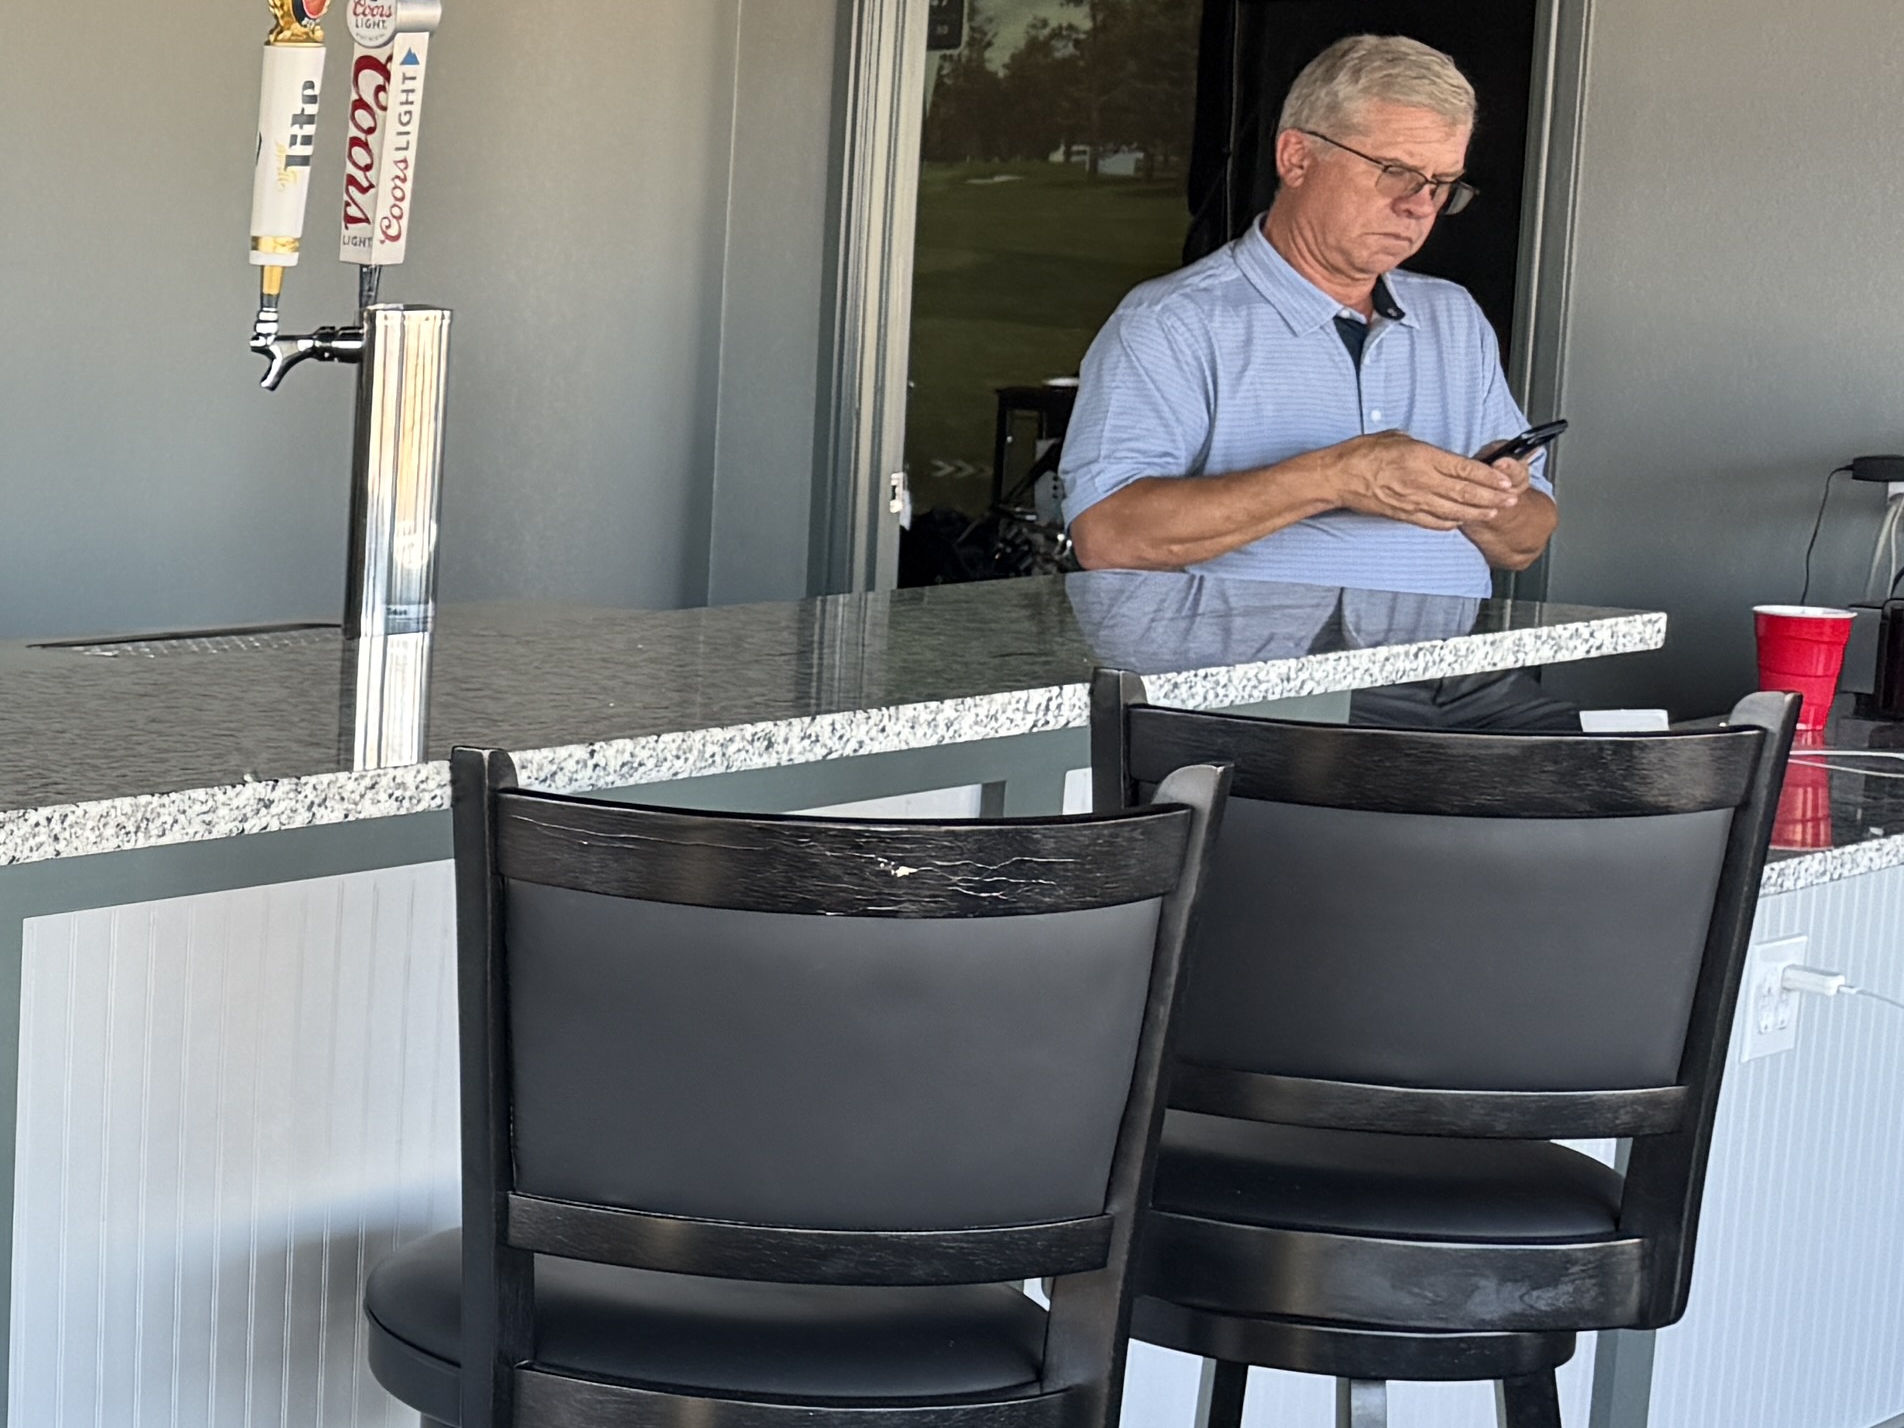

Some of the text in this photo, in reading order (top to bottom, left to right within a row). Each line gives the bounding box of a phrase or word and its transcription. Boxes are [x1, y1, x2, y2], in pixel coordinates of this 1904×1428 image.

[355, 19, 387, 29] LIGHT
[343, 52, 393, 231] Coors
[379, 73, 418, 244] Coors LIGHT
[342, 235, 373, 248] LIGHT
